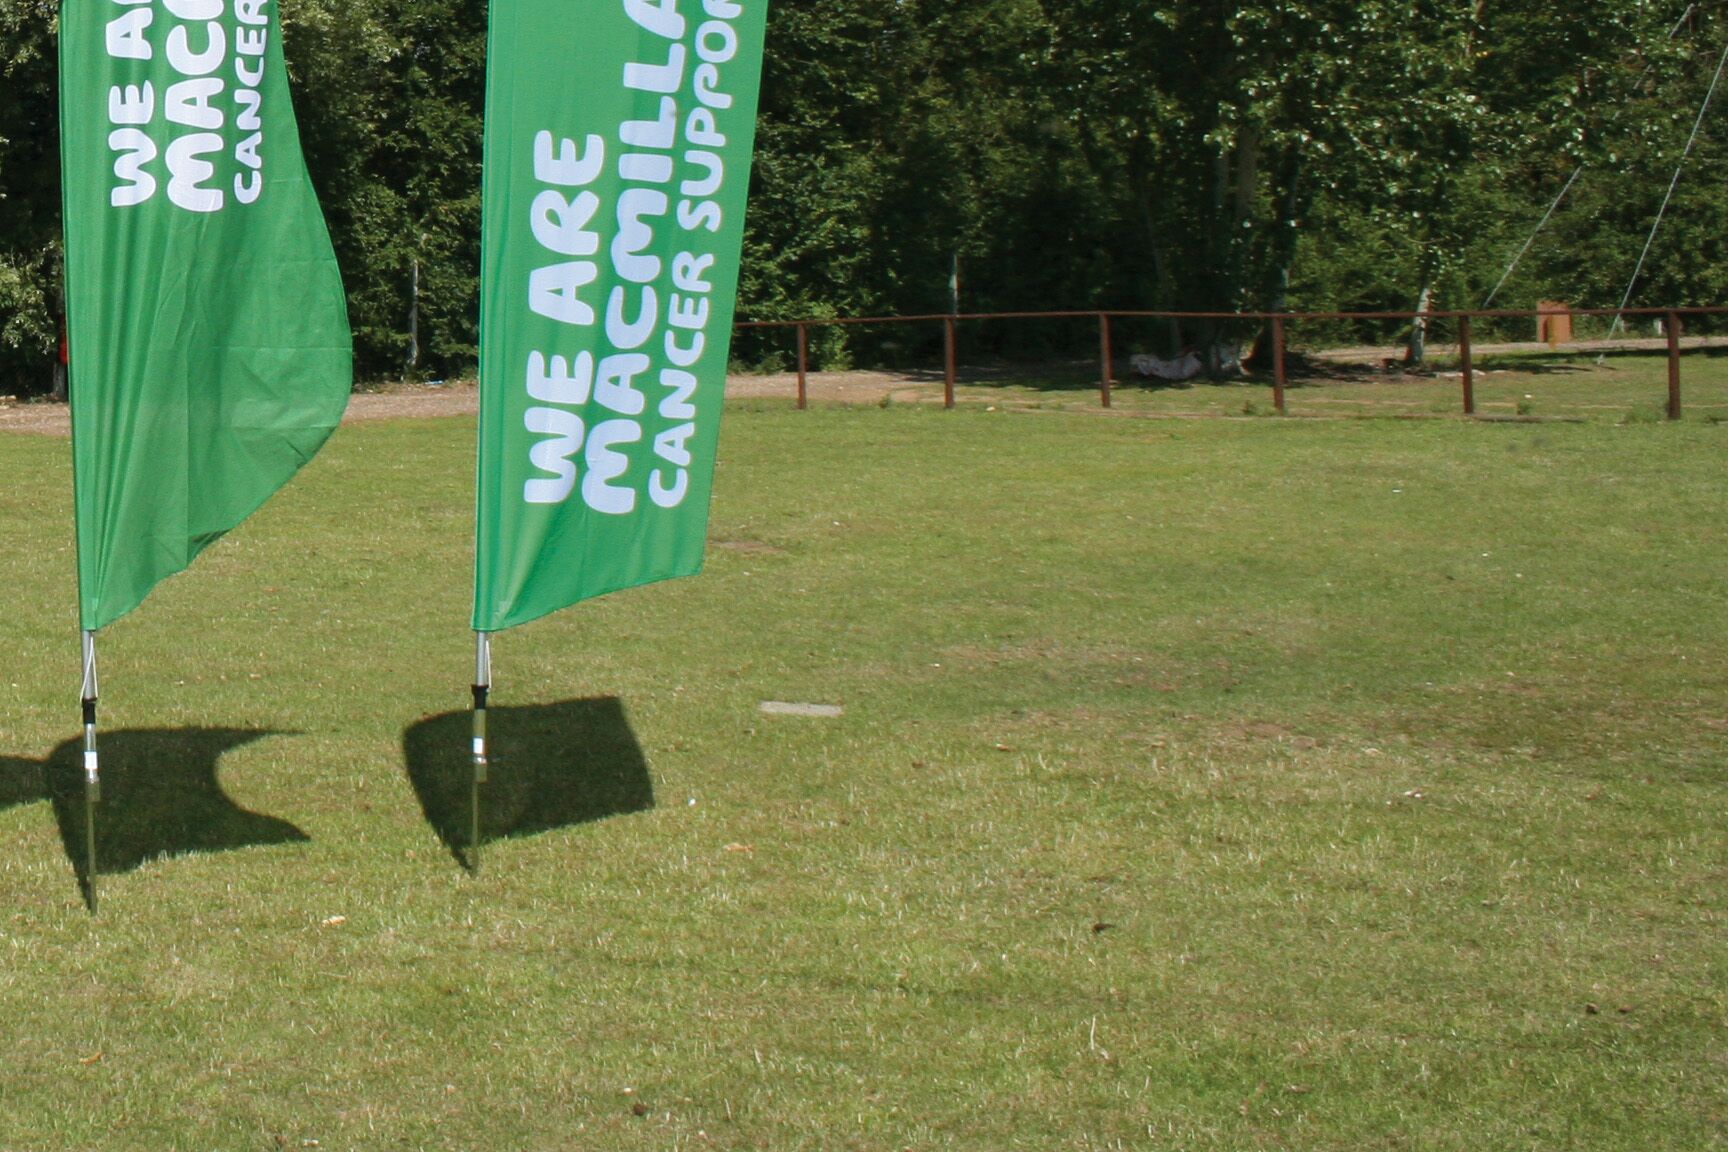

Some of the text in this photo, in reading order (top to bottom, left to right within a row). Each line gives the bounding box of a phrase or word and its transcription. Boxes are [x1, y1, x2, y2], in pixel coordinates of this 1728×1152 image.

[108, 80, 158, 206] WE
[524, 130, 605, 504] WE ARE
[649, 252, 714, 508] CANCER
